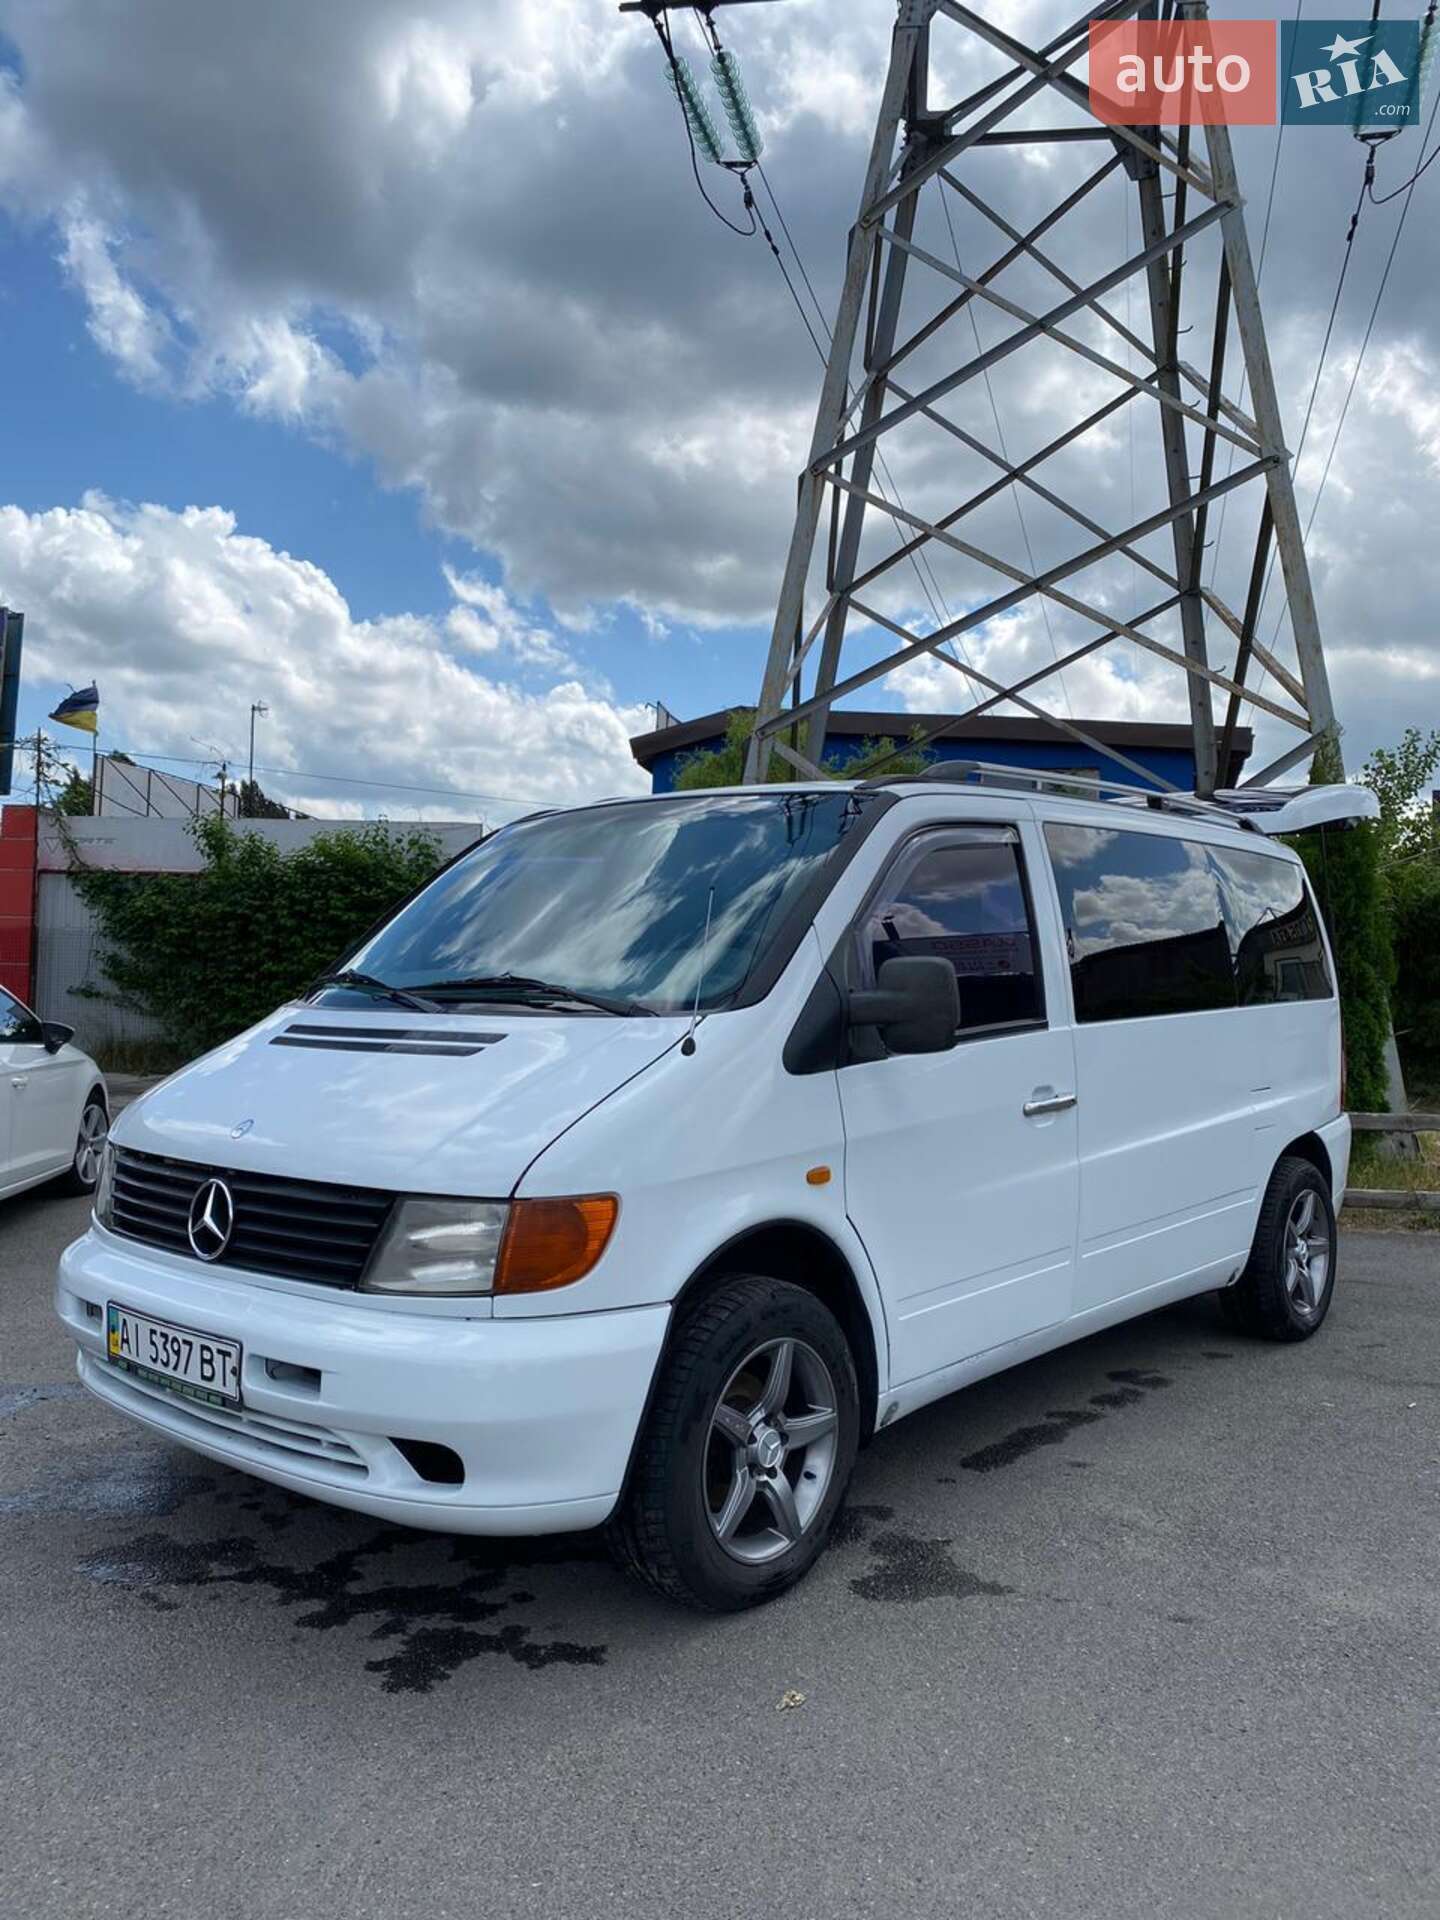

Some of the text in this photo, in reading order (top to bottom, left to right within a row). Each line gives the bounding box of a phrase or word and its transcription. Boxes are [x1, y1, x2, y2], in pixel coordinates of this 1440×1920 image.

[120, 1318, 139, 1358] AI
[149, 1328, 194, 1375] 5397
[200, 1344, 232, 1387] BT
